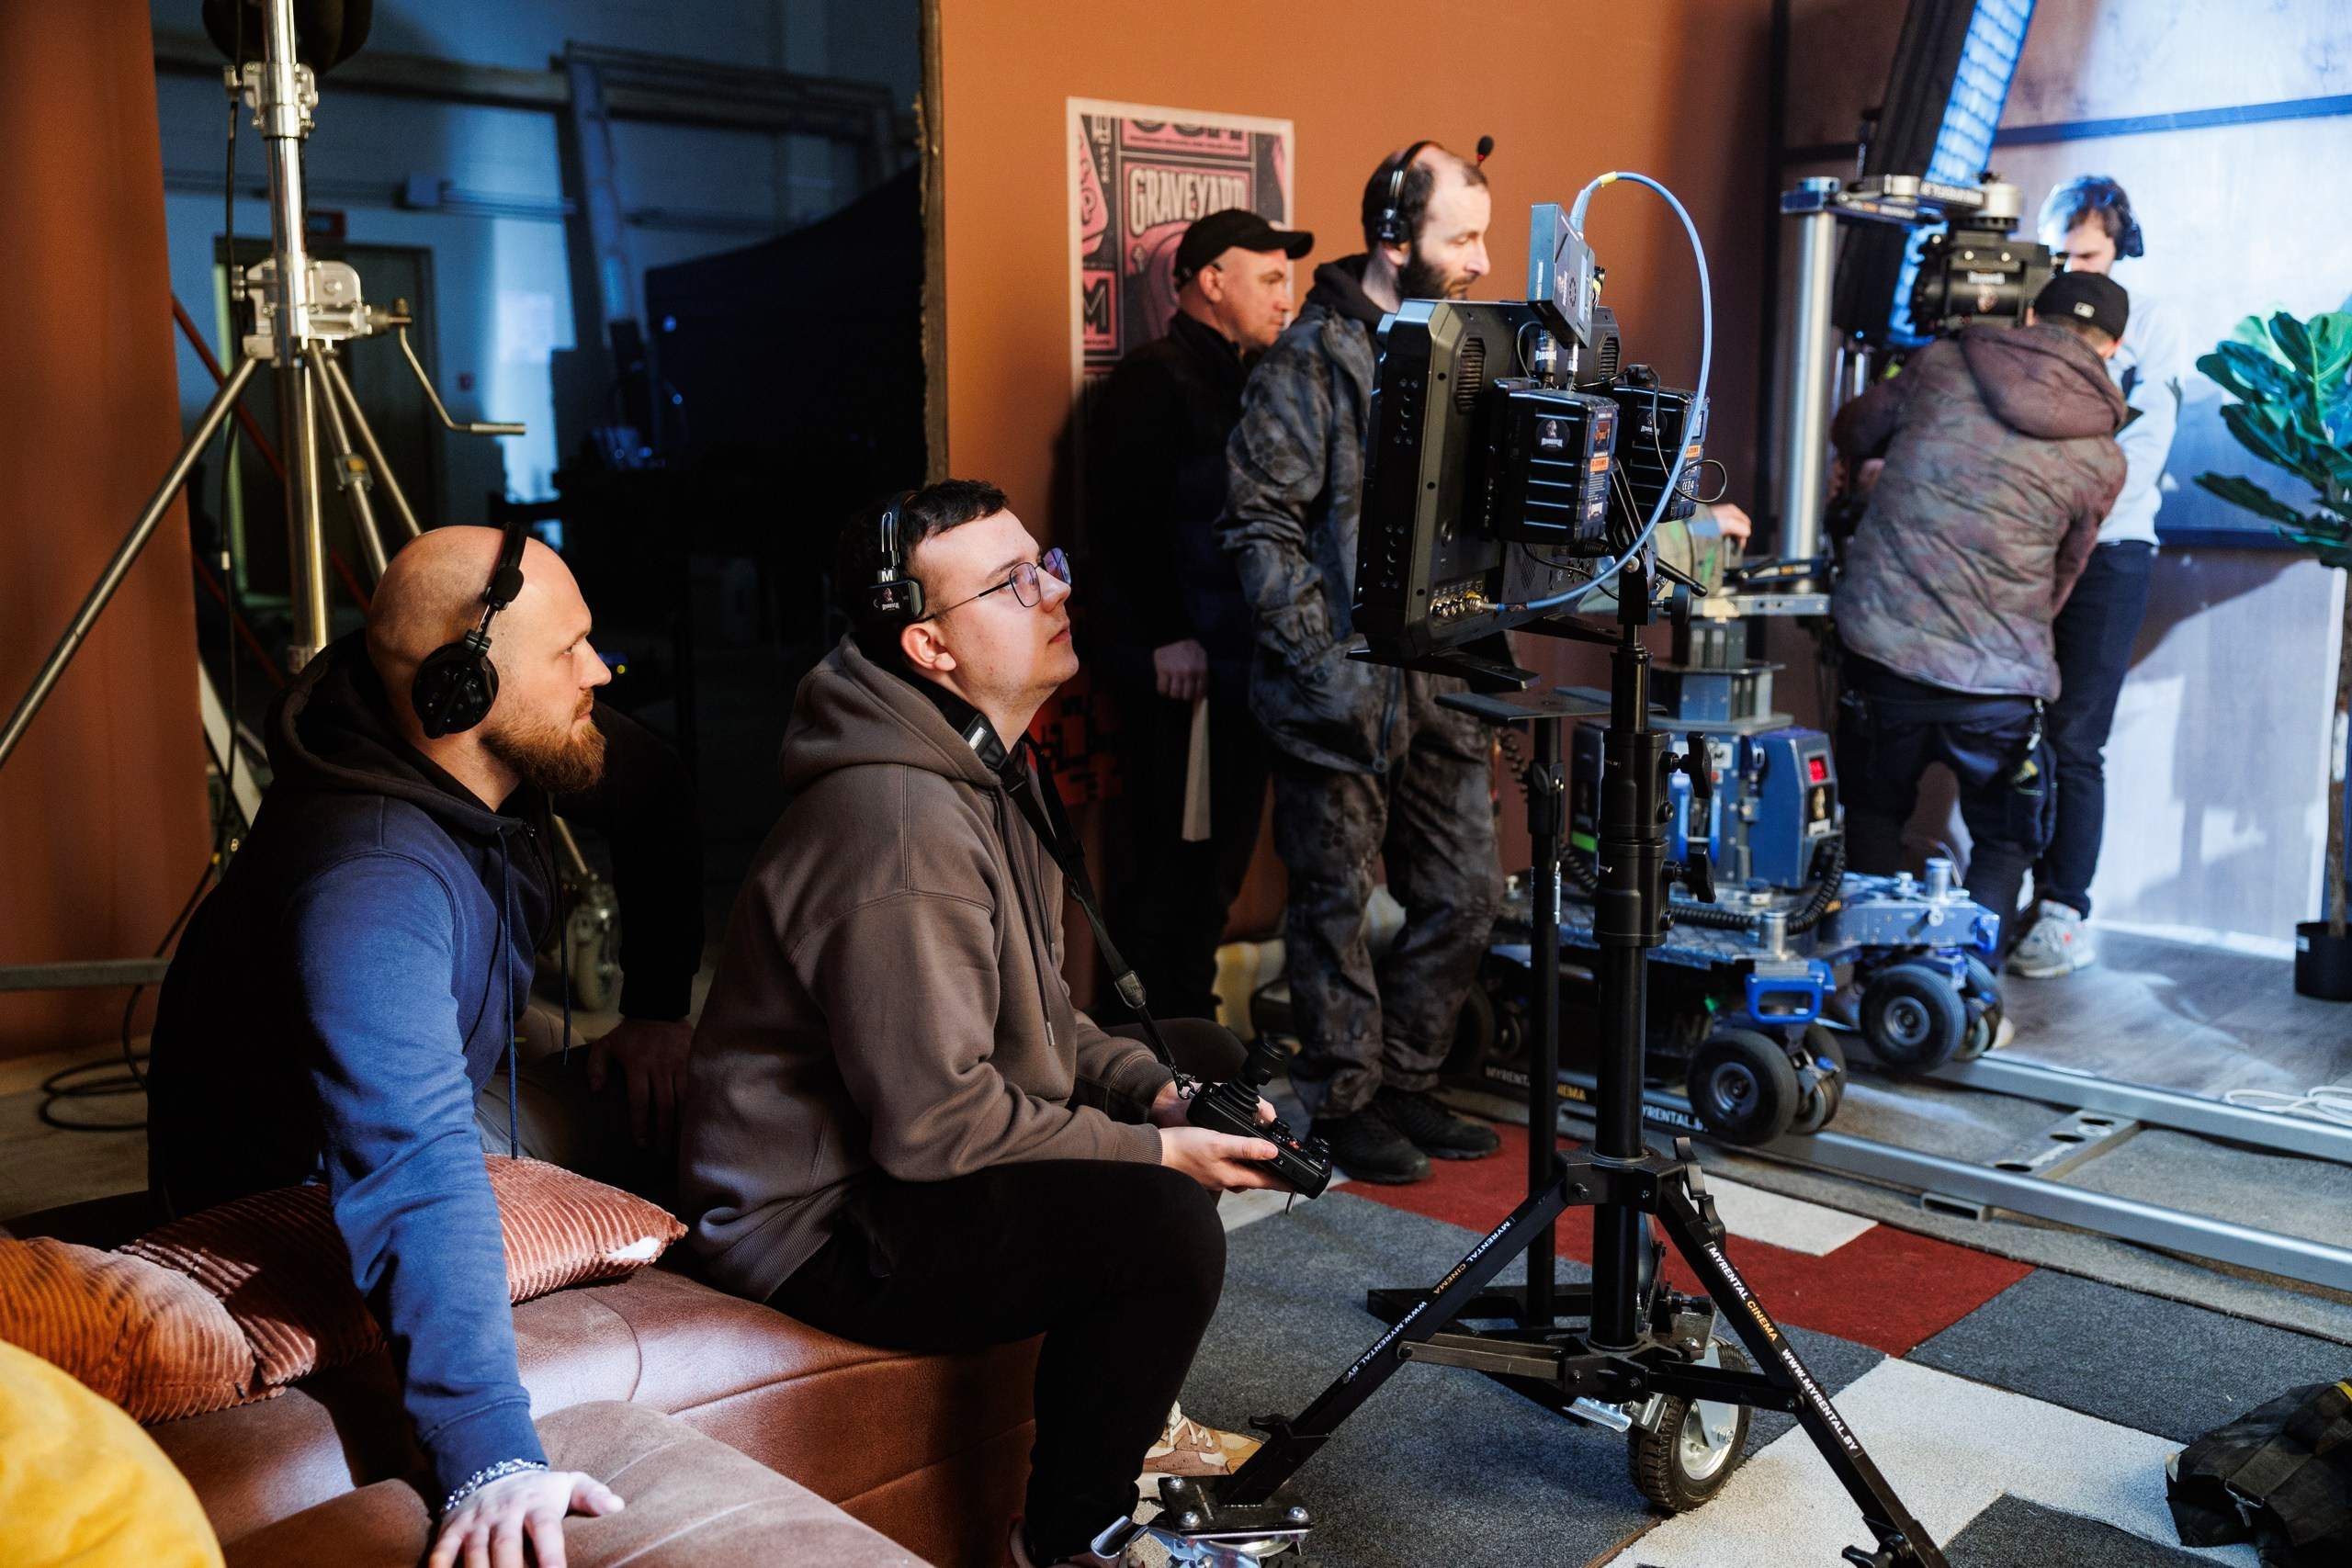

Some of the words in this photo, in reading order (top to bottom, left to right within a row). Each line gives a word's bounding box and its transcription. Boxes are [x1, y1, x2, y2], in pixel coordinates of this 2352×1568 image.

[1129, 167, 1247, 237] GRAVEYARD
[881, 569, 894, 582] M
[1556, 1085, 1587, 1101] NEMA
[1465, 1220, 1512, 1262] MYRENTAL
[1432, 1263, 1467, 1295] CINEMA
[1345, 1301, 1429, 1380] WWW.MYRENTAL.BY
[1708, 1247, 1749, 1301] MYRENTAL
[1747, 1301, 1778, 1342] CINEMA
[1781, 1348, 1859, 1451] WWW.MYRENTAL.BY
